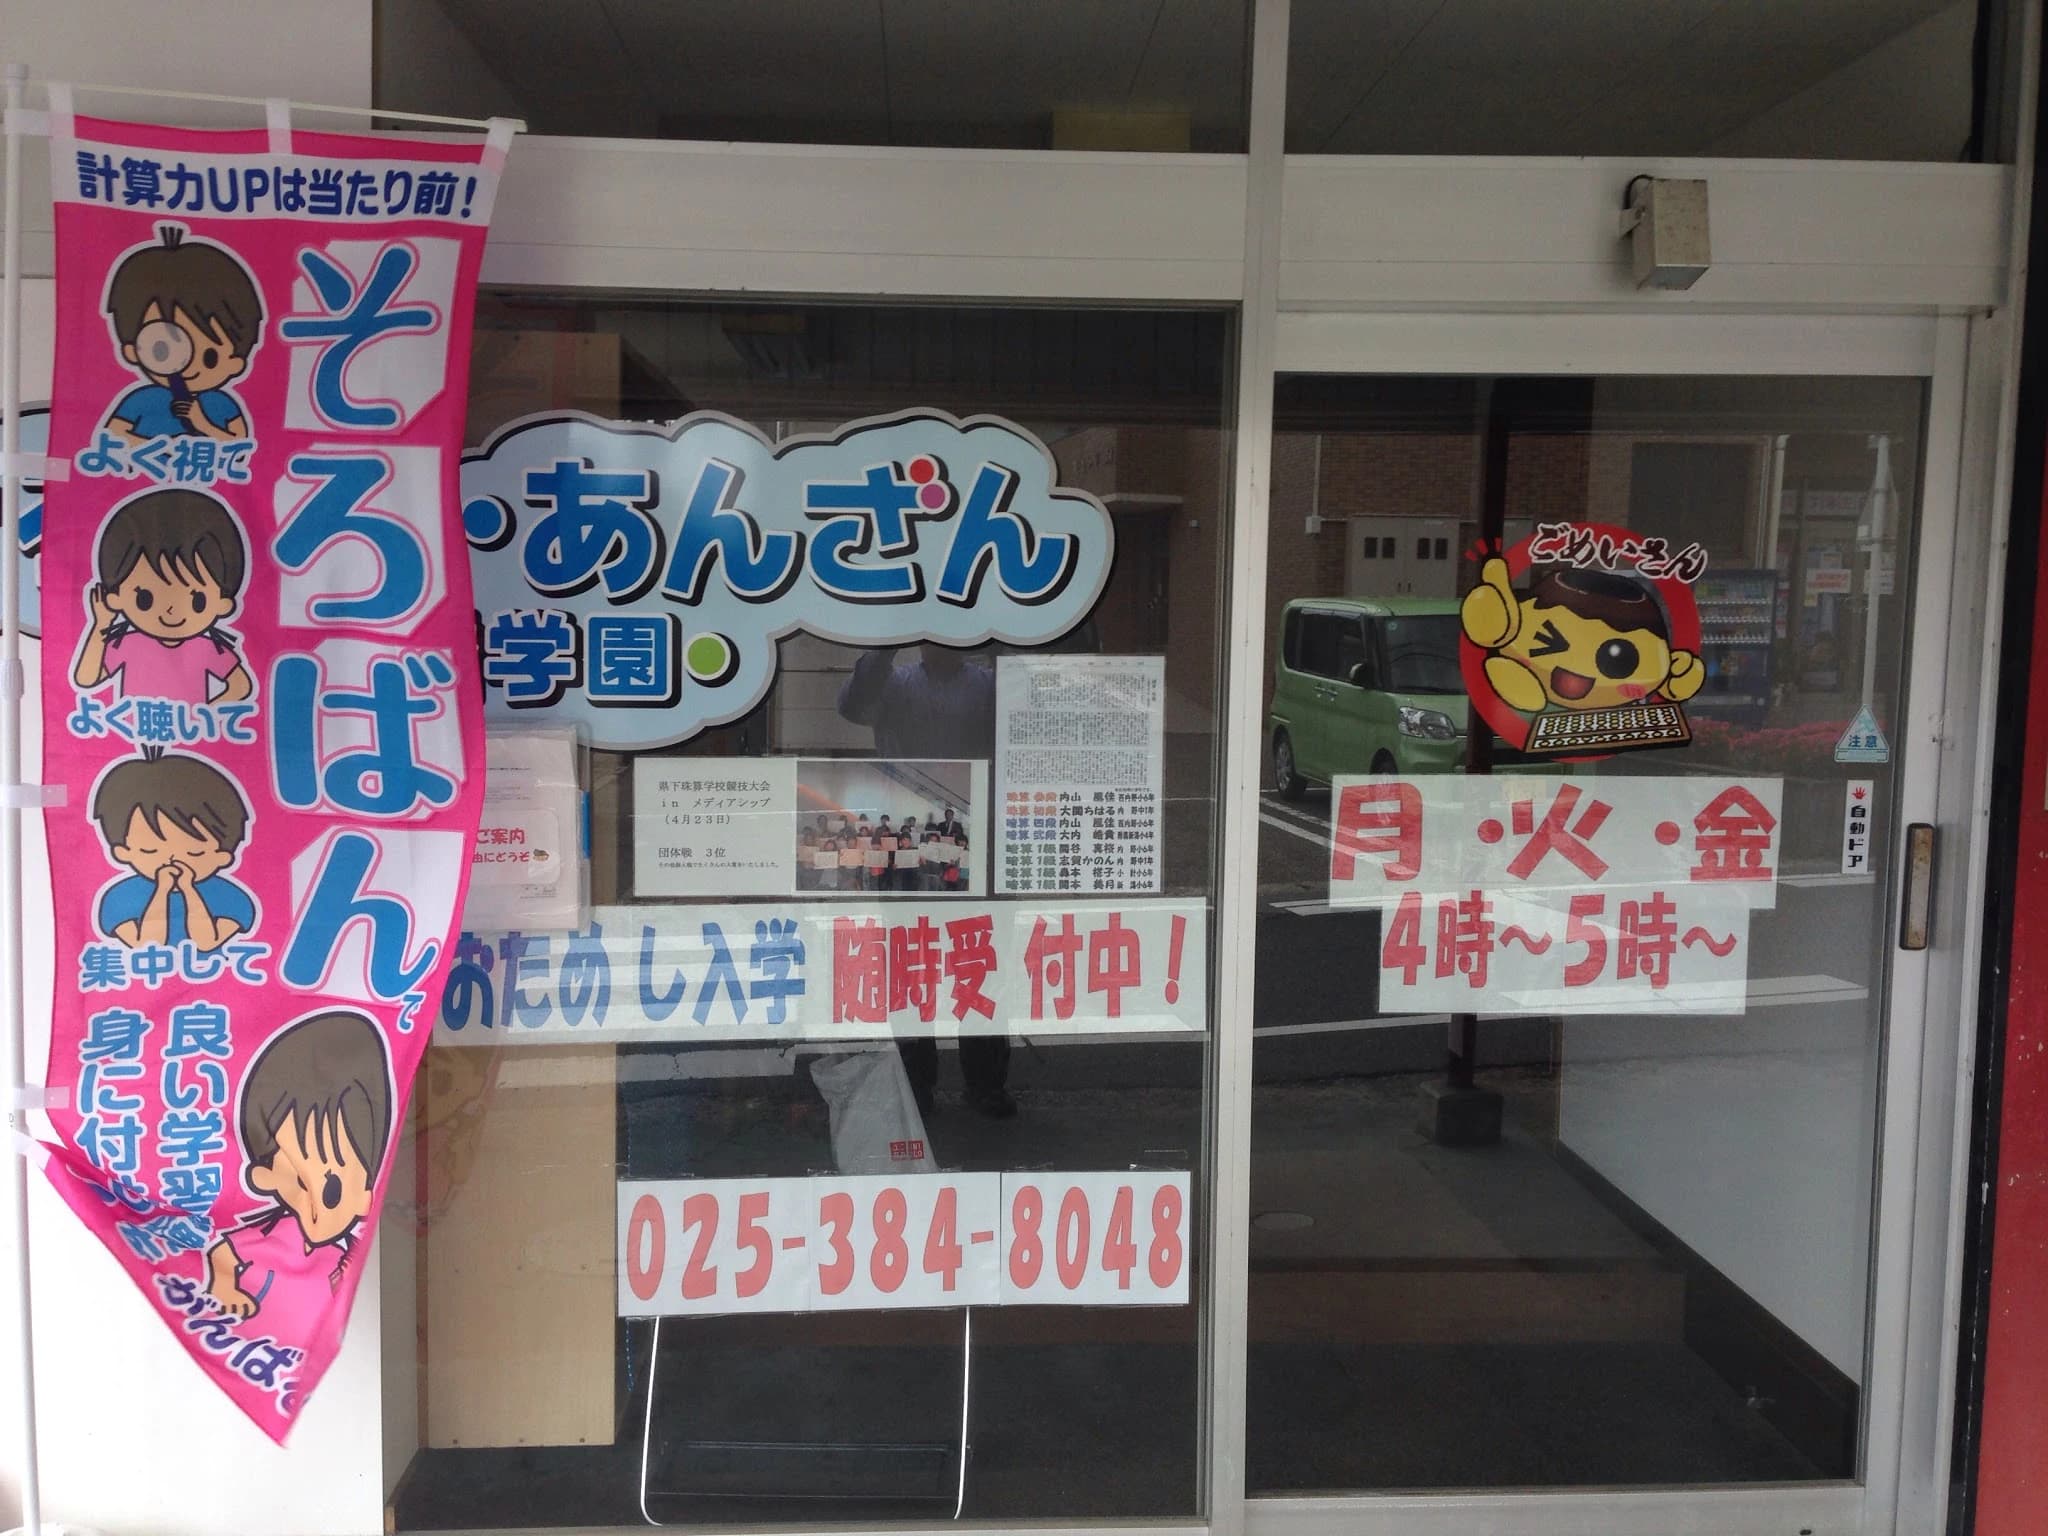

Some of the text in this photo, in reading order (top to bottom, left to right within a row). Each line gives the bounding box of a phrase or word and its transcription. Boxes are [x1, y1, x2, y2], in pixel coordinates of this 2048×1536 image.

[80, 433, 254, 482] よく視て
[1529, 523, 1708, 583] ごめいさん
[70, 697, 255, 742] よく聴いて
[1848, 734, 1877, 748] 注意
[658, 847, 692, 858] 団体戦
[1847, 804, 1866, 868] 自動ドア
[82, 945, 268, 988] 集中して
[626, 1184, 1183, 1302] 025-384-8048
